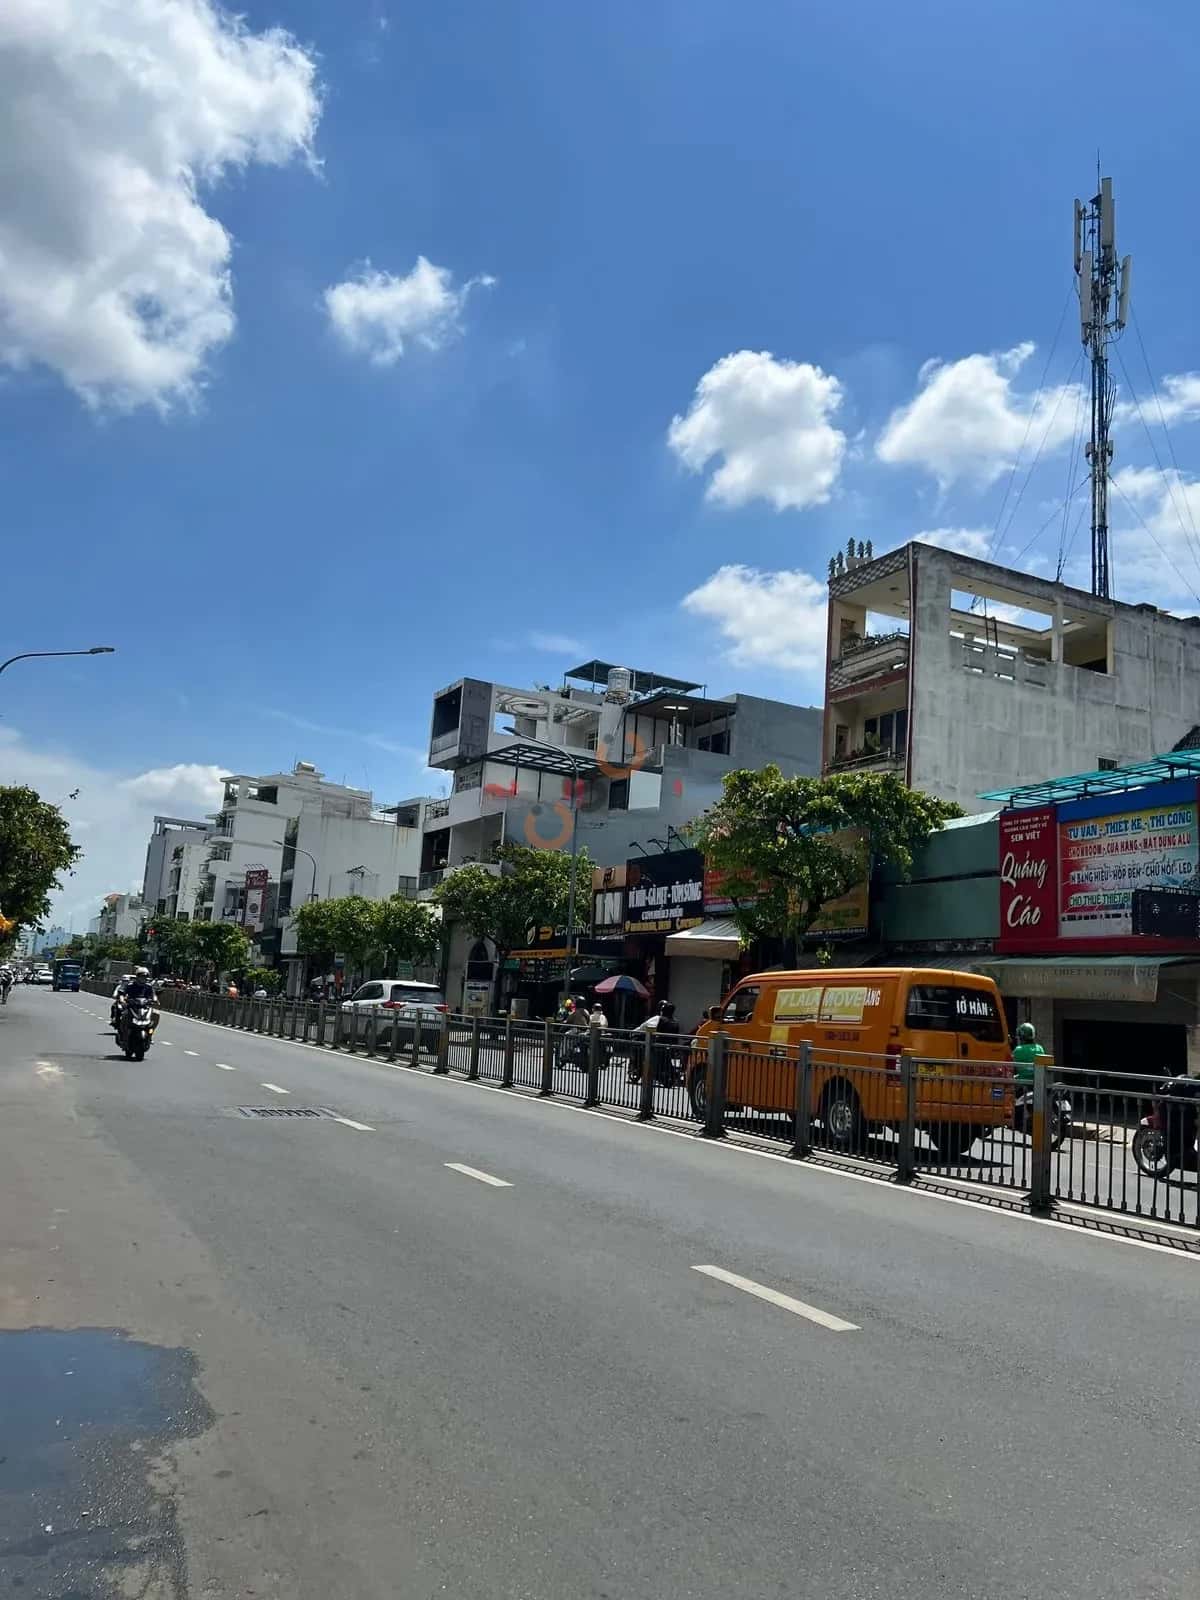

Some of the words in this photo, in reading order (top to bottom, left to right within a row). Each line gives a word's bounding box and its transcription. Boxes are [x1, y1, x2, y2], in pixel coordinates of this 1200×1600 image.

[1149, 814, 1165, 828] THI
[1179, 862, 1193, 875] LED
[1006, 895, 1041, 928] Cáo
